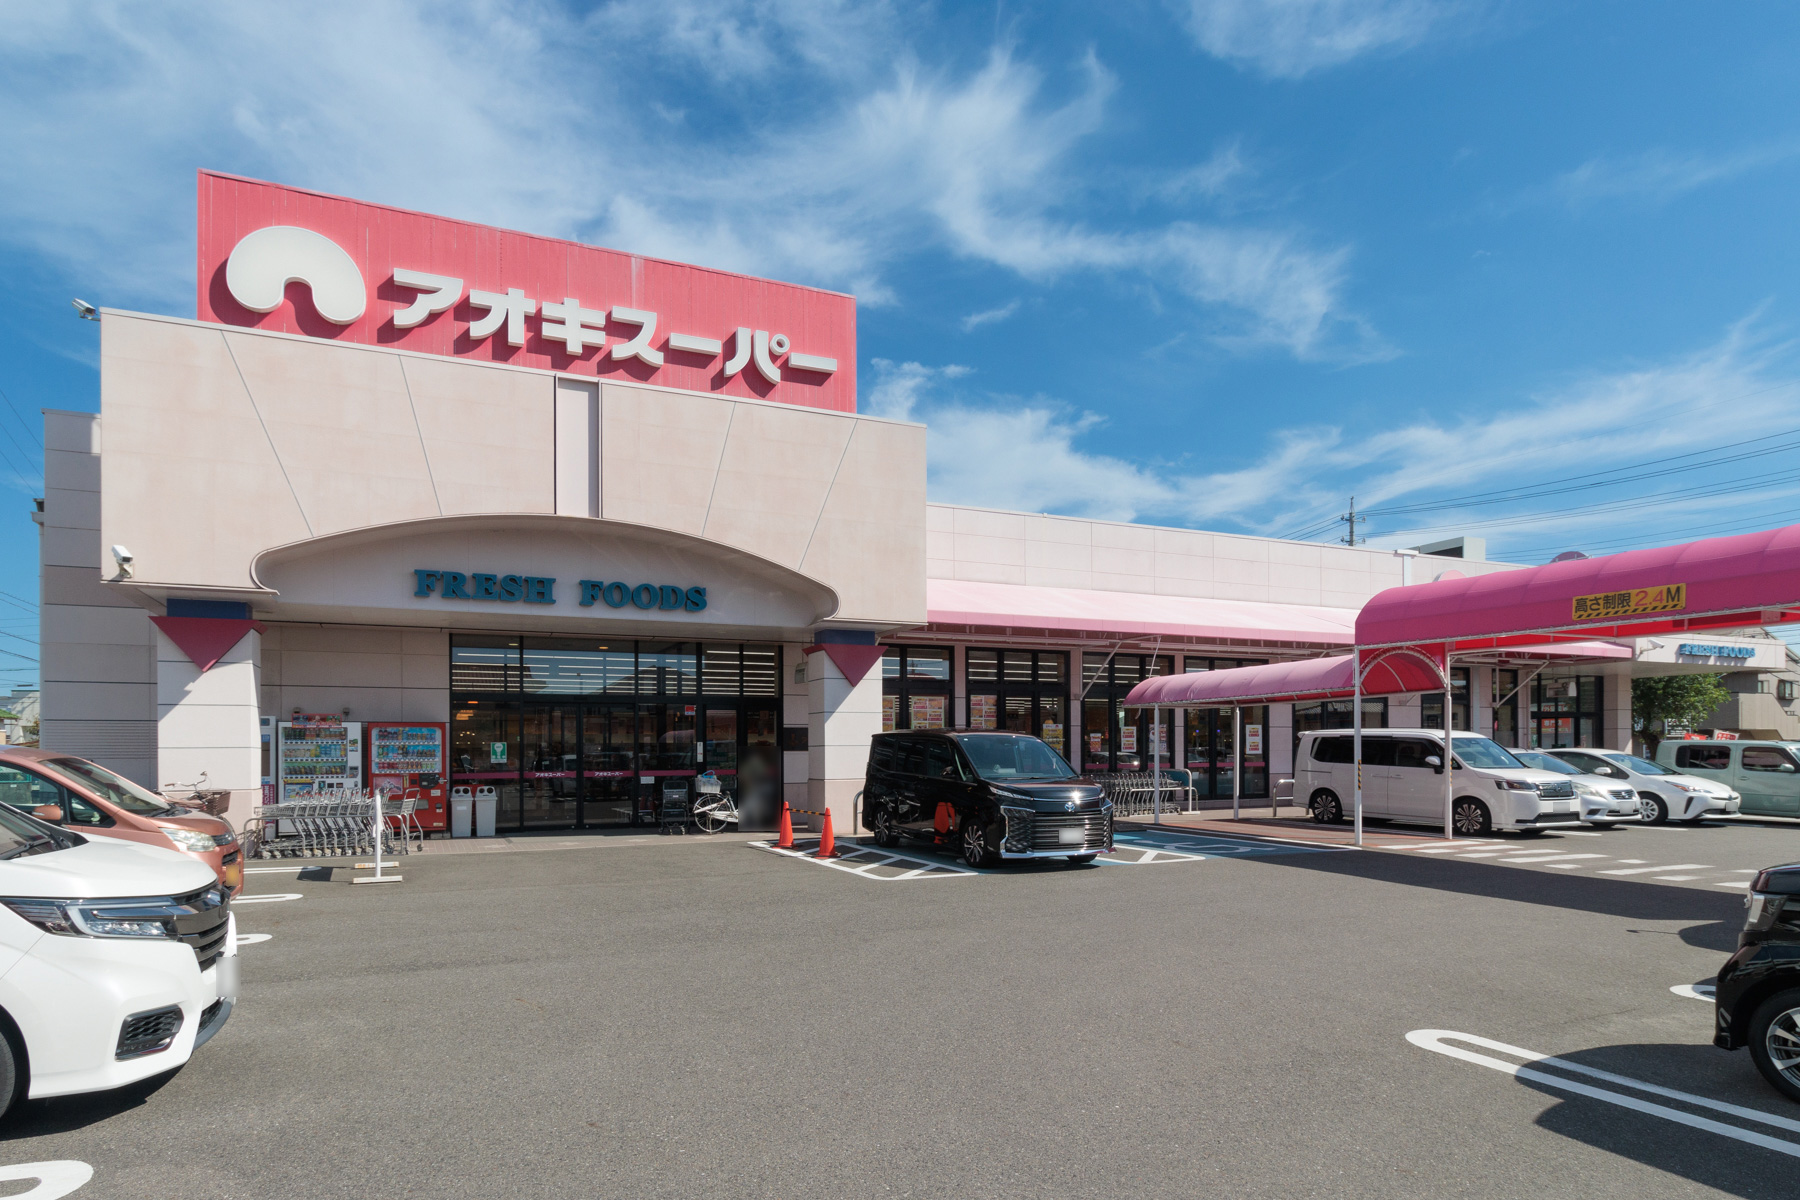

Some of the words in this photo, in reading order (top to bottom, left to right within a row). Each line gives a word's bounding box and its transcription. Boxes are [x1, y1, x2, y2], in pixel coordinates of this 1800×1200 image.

[392, 266, 838, 385] アオキスーパー
[414, 568, 557, 605] FRESH
[578, 579, 708, 612] FOODS
[1682, 643, 1719, 657] FRESH
[1721, 645, 1756, 659] FOODS
